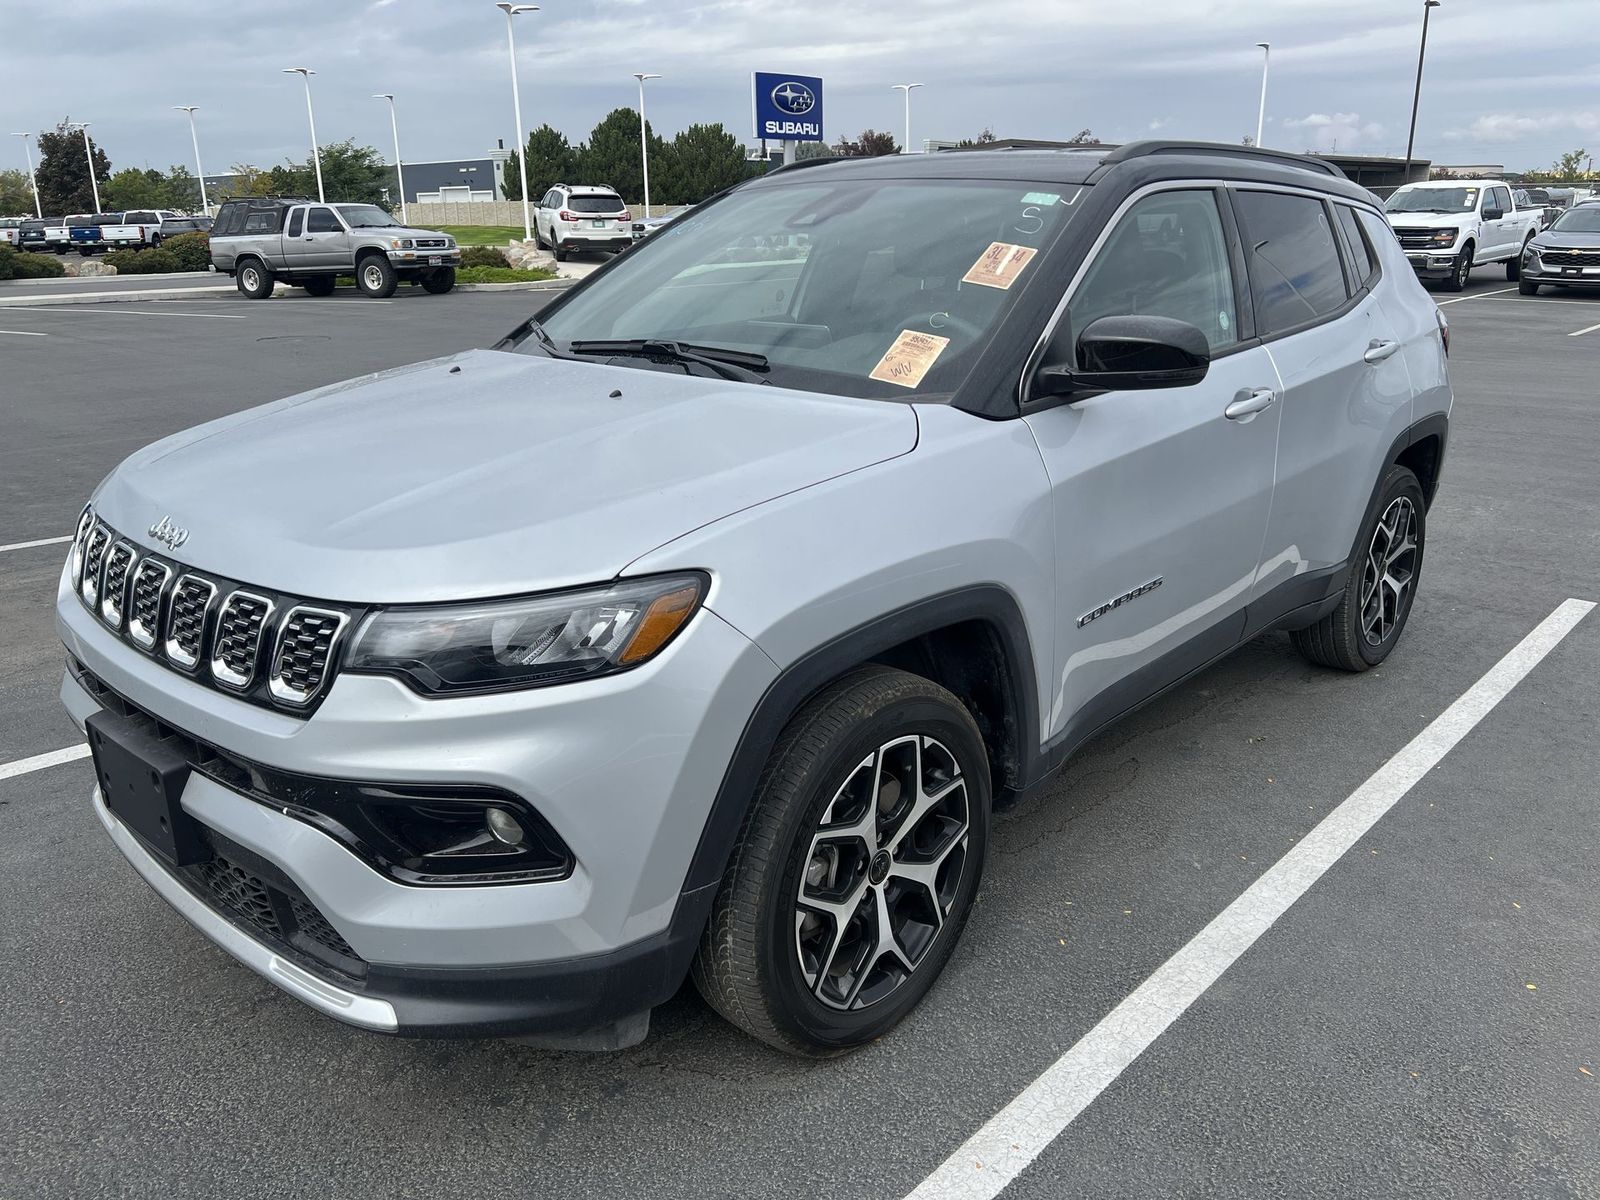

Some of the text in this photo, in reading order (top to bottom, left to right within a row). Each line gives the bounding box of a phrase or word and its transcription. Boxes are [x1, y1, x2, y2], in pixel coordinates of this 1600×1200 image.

[765, 121, 819, 136] SUBARU
[148, 515, 189, 551] Jeep
[1076, 575, 1164, 629] COMPASS
